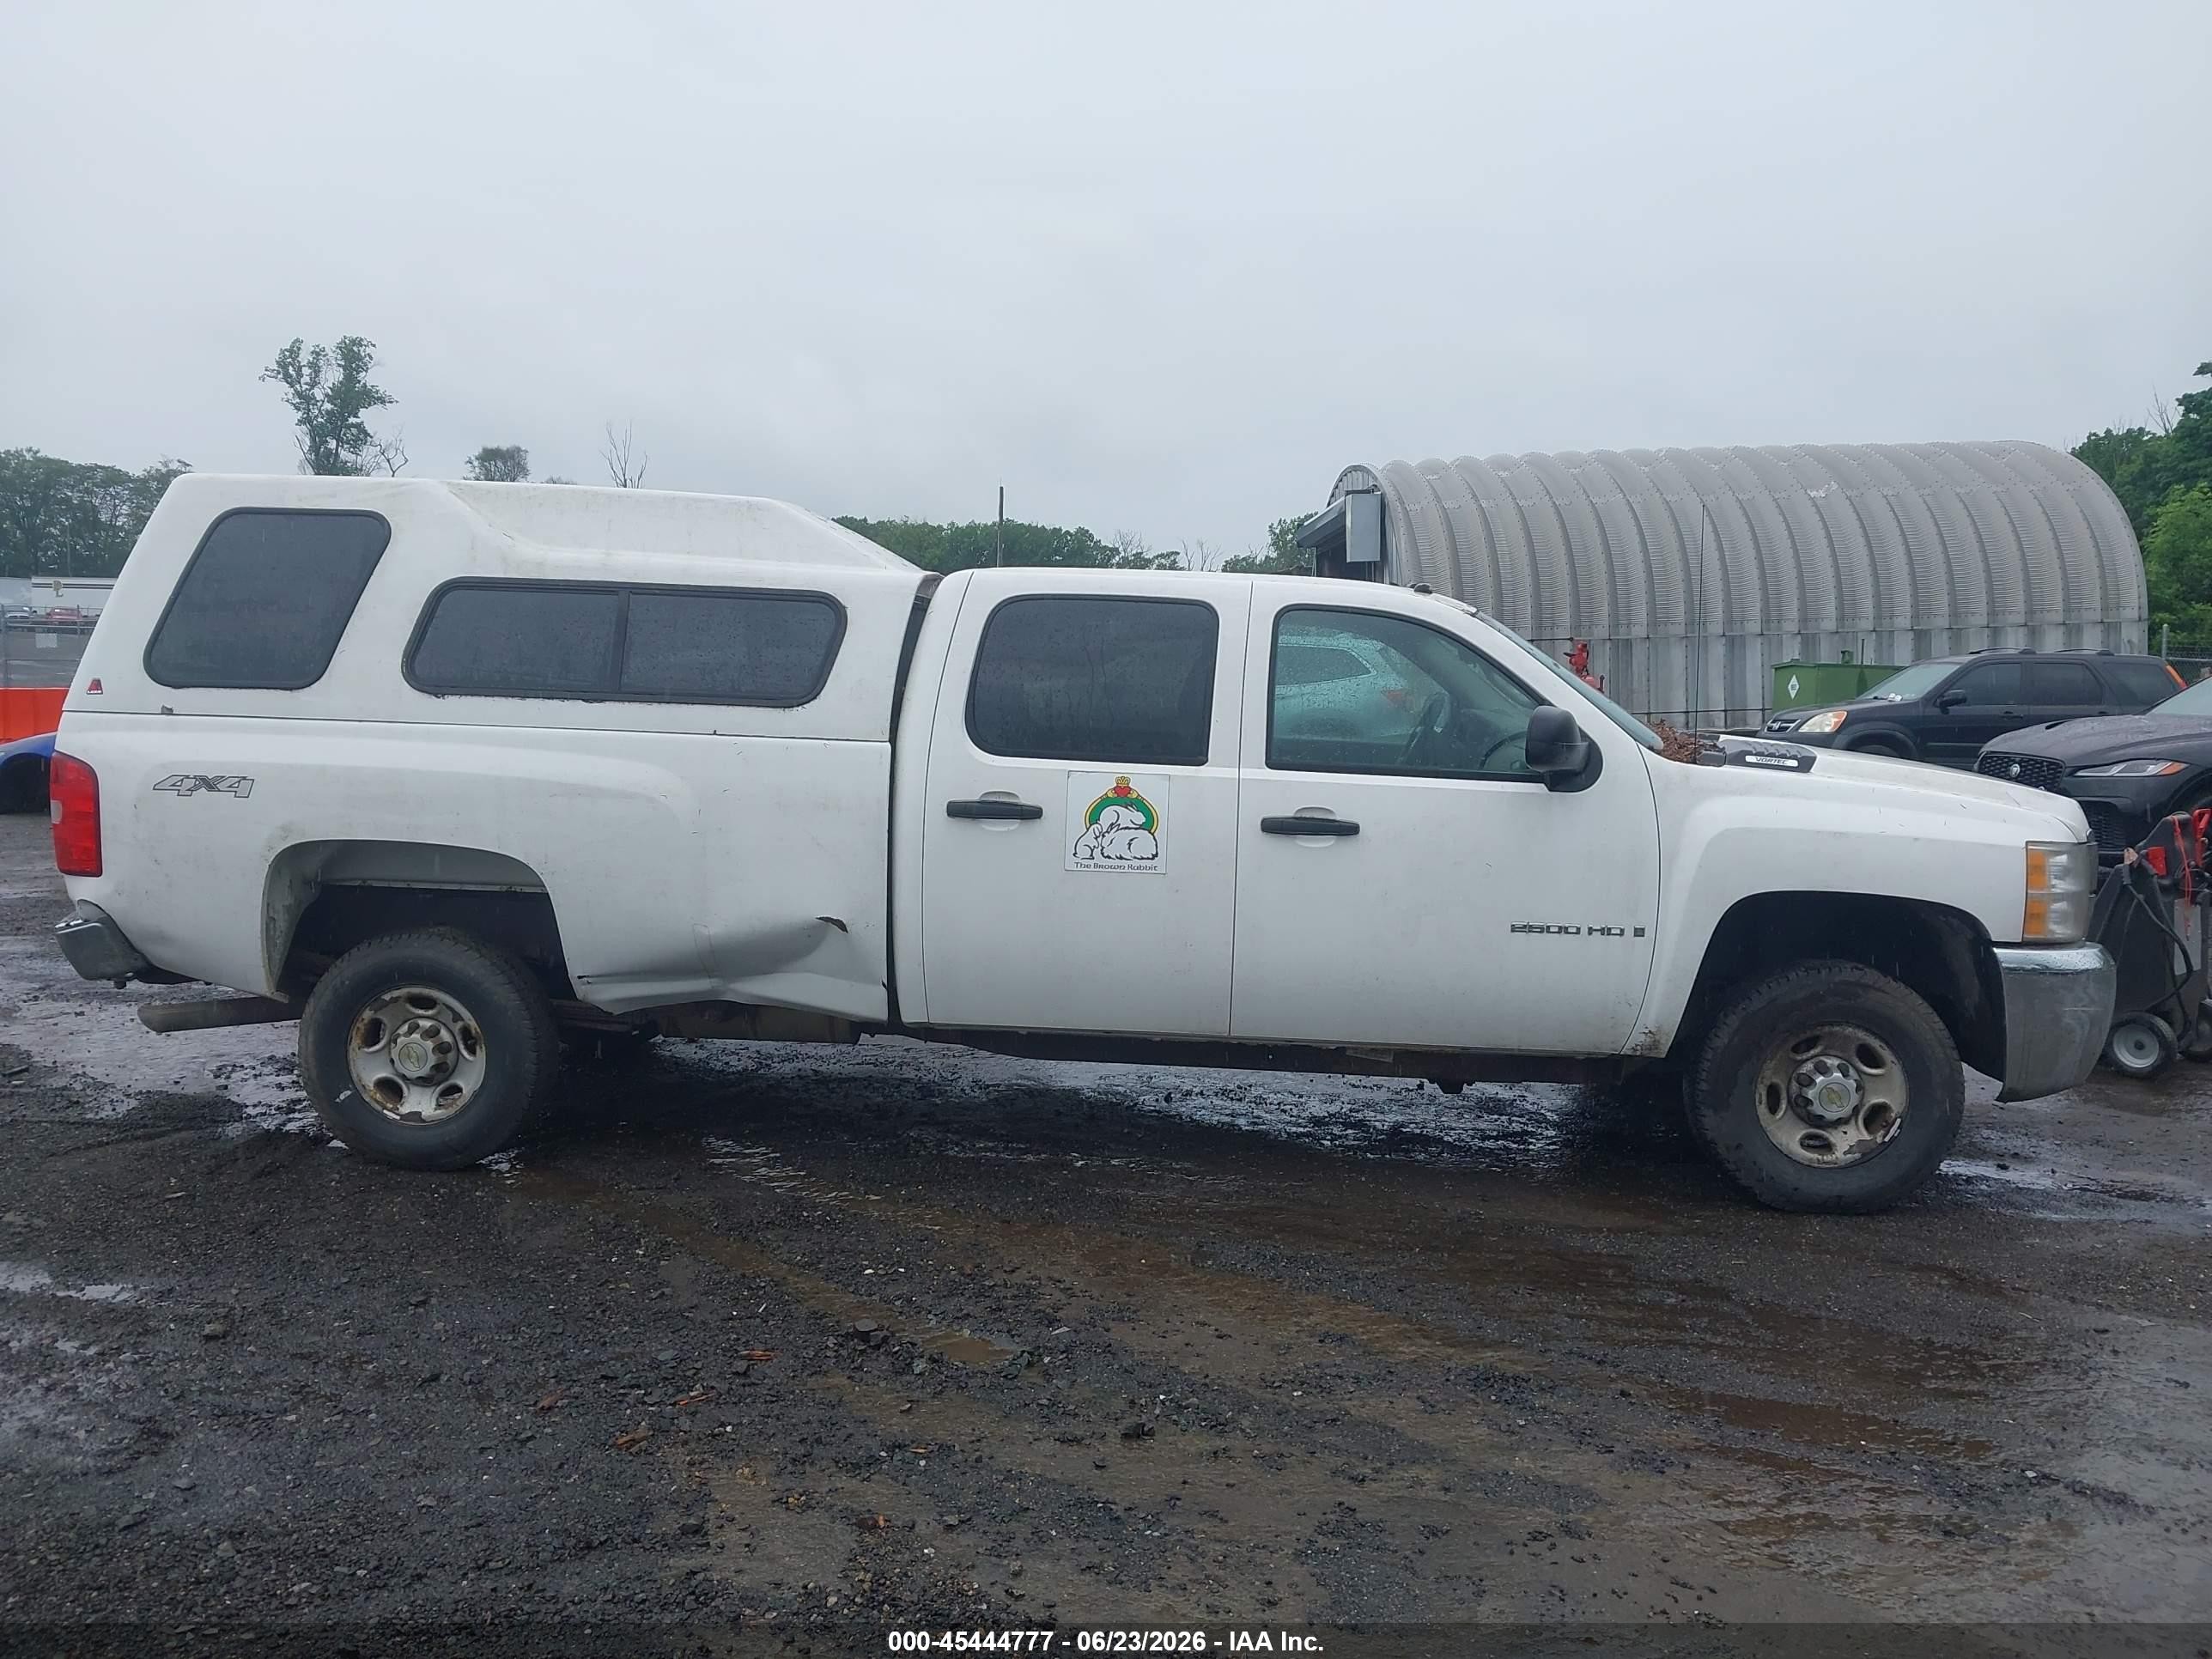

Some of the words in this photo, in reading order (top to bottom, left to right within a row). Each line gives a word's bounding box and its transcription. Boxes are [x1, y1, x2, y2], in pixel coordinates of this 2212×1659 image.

[1754, 757, 1788, 765] VORTEC
[1093, 862, 1126, 871] Brown
[1127, 863, 1158, 872] Rabbit
[1510, 921, 1581, 935] 2500
[1587, 924, 1625, 937] HD
